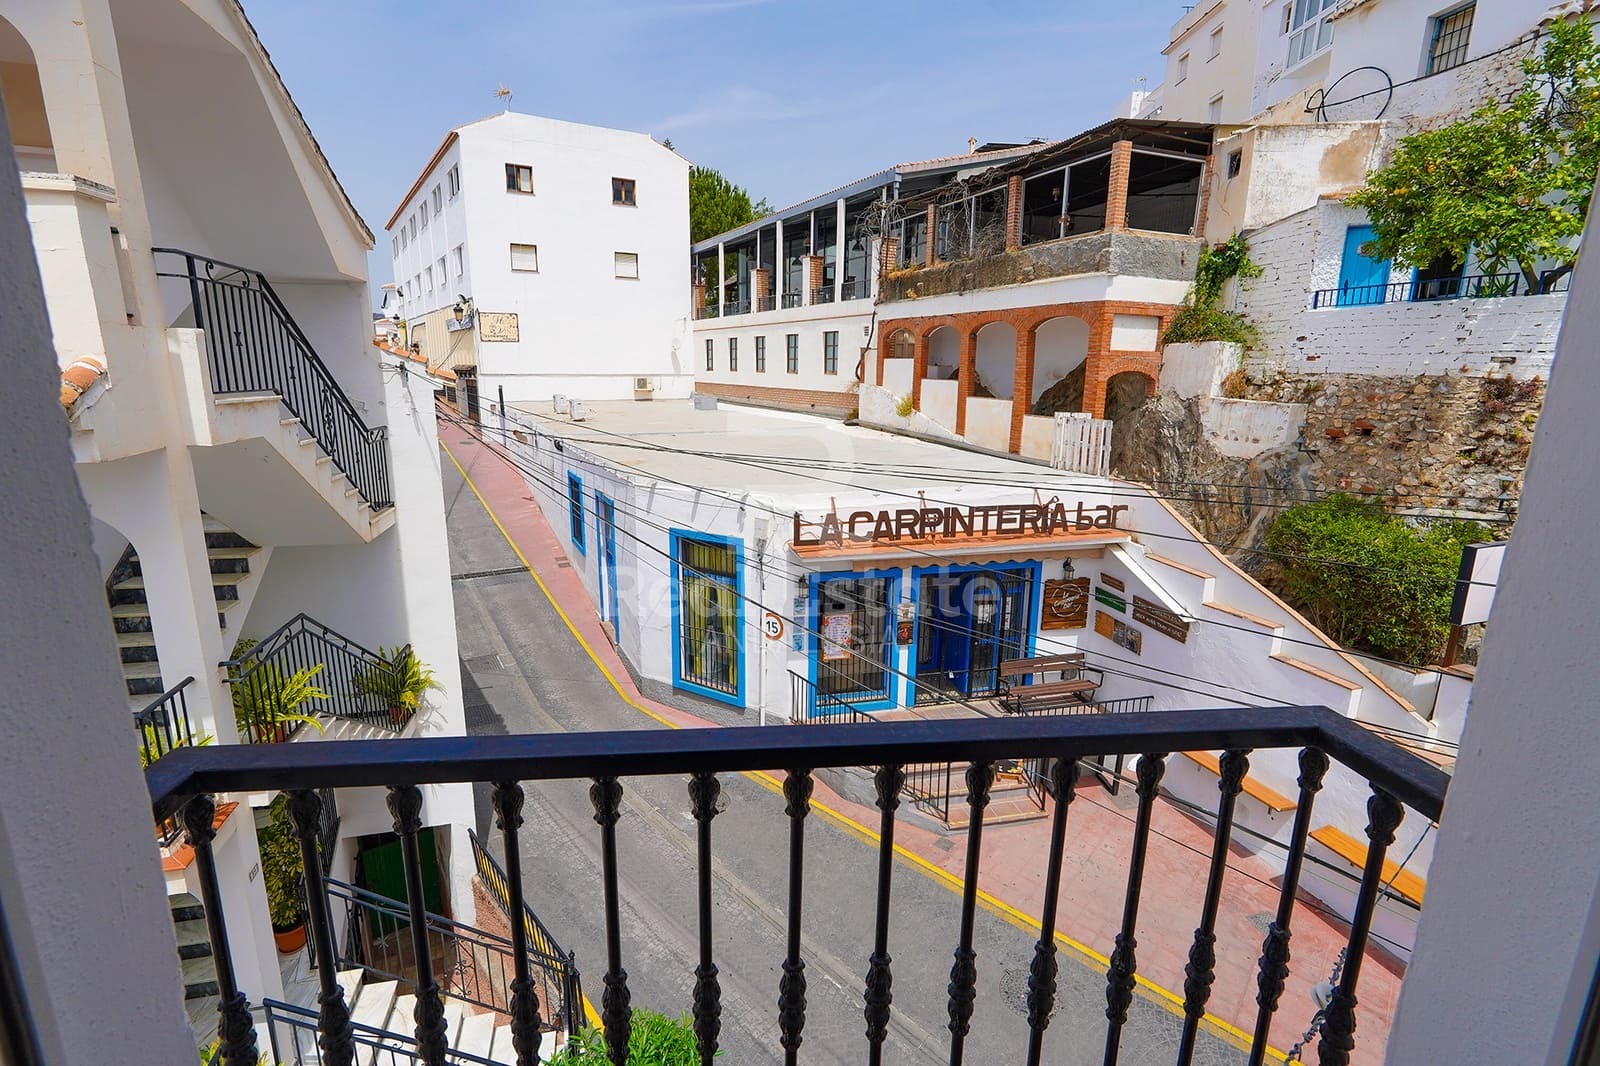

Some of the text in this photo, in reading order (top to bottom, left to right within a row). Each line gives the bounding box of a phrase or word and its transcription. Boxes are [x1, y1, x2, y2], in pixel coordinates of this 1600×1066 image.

[794, 512, 843, 546] LA
[1076, 501, 1129, 531] bar
[766, 620, 778, 634] 15
